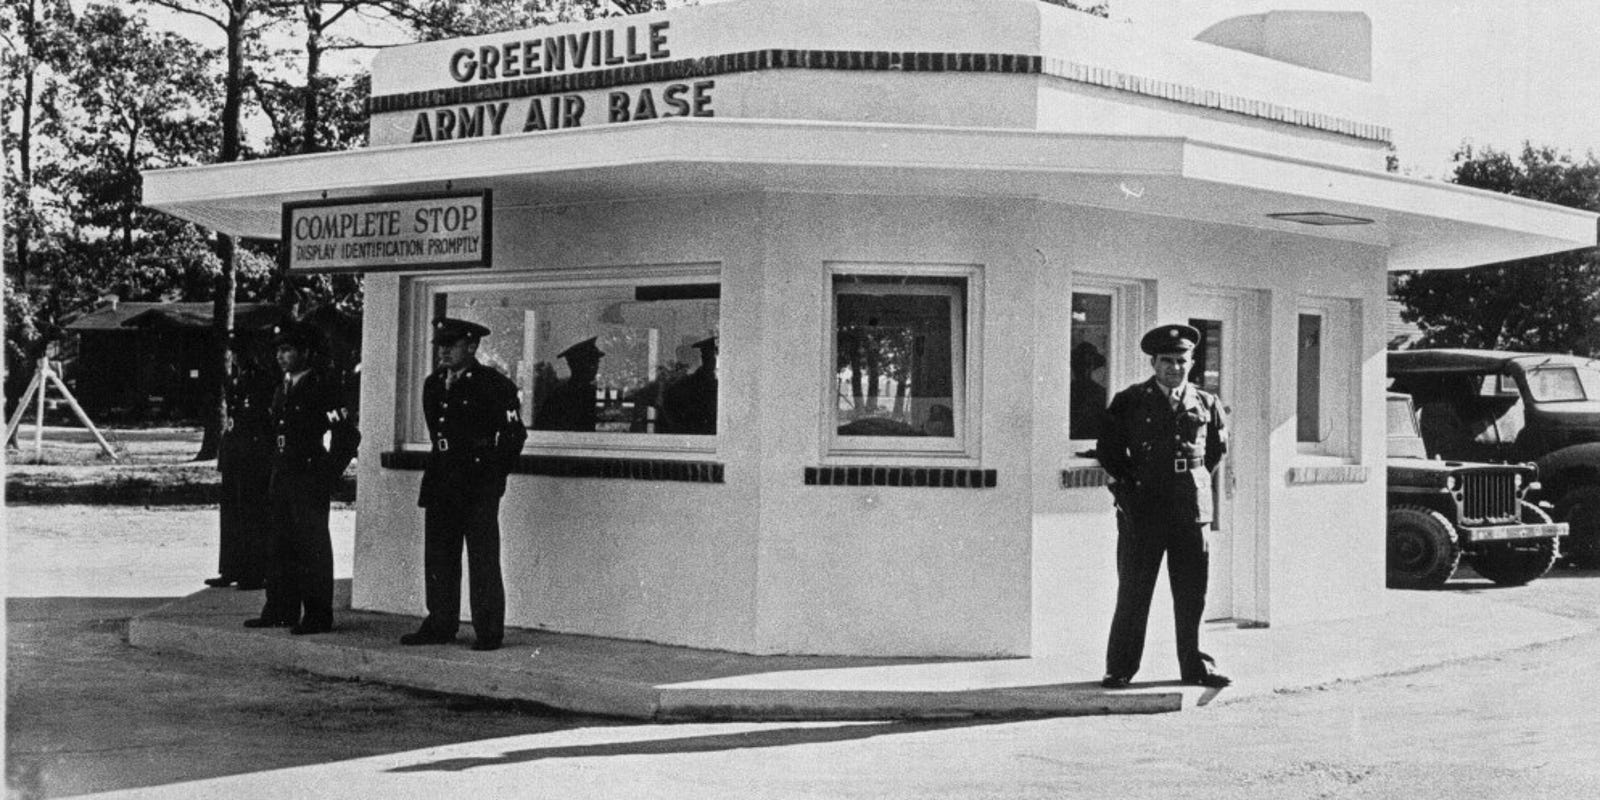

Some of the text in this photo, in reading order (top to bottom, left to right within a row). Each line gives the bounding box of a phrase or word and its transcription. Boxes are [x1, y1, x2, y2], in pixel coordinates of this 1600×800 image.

[450, 20, 671, 83] GREENVILLE
[410, 80, 715, 143] ARMY AIR BASE
[296, 204, 478, 241] COMPLETE STOP
[296, 235, 480, 261] DISPLAY IDENTIFICATION PROMPTLY
